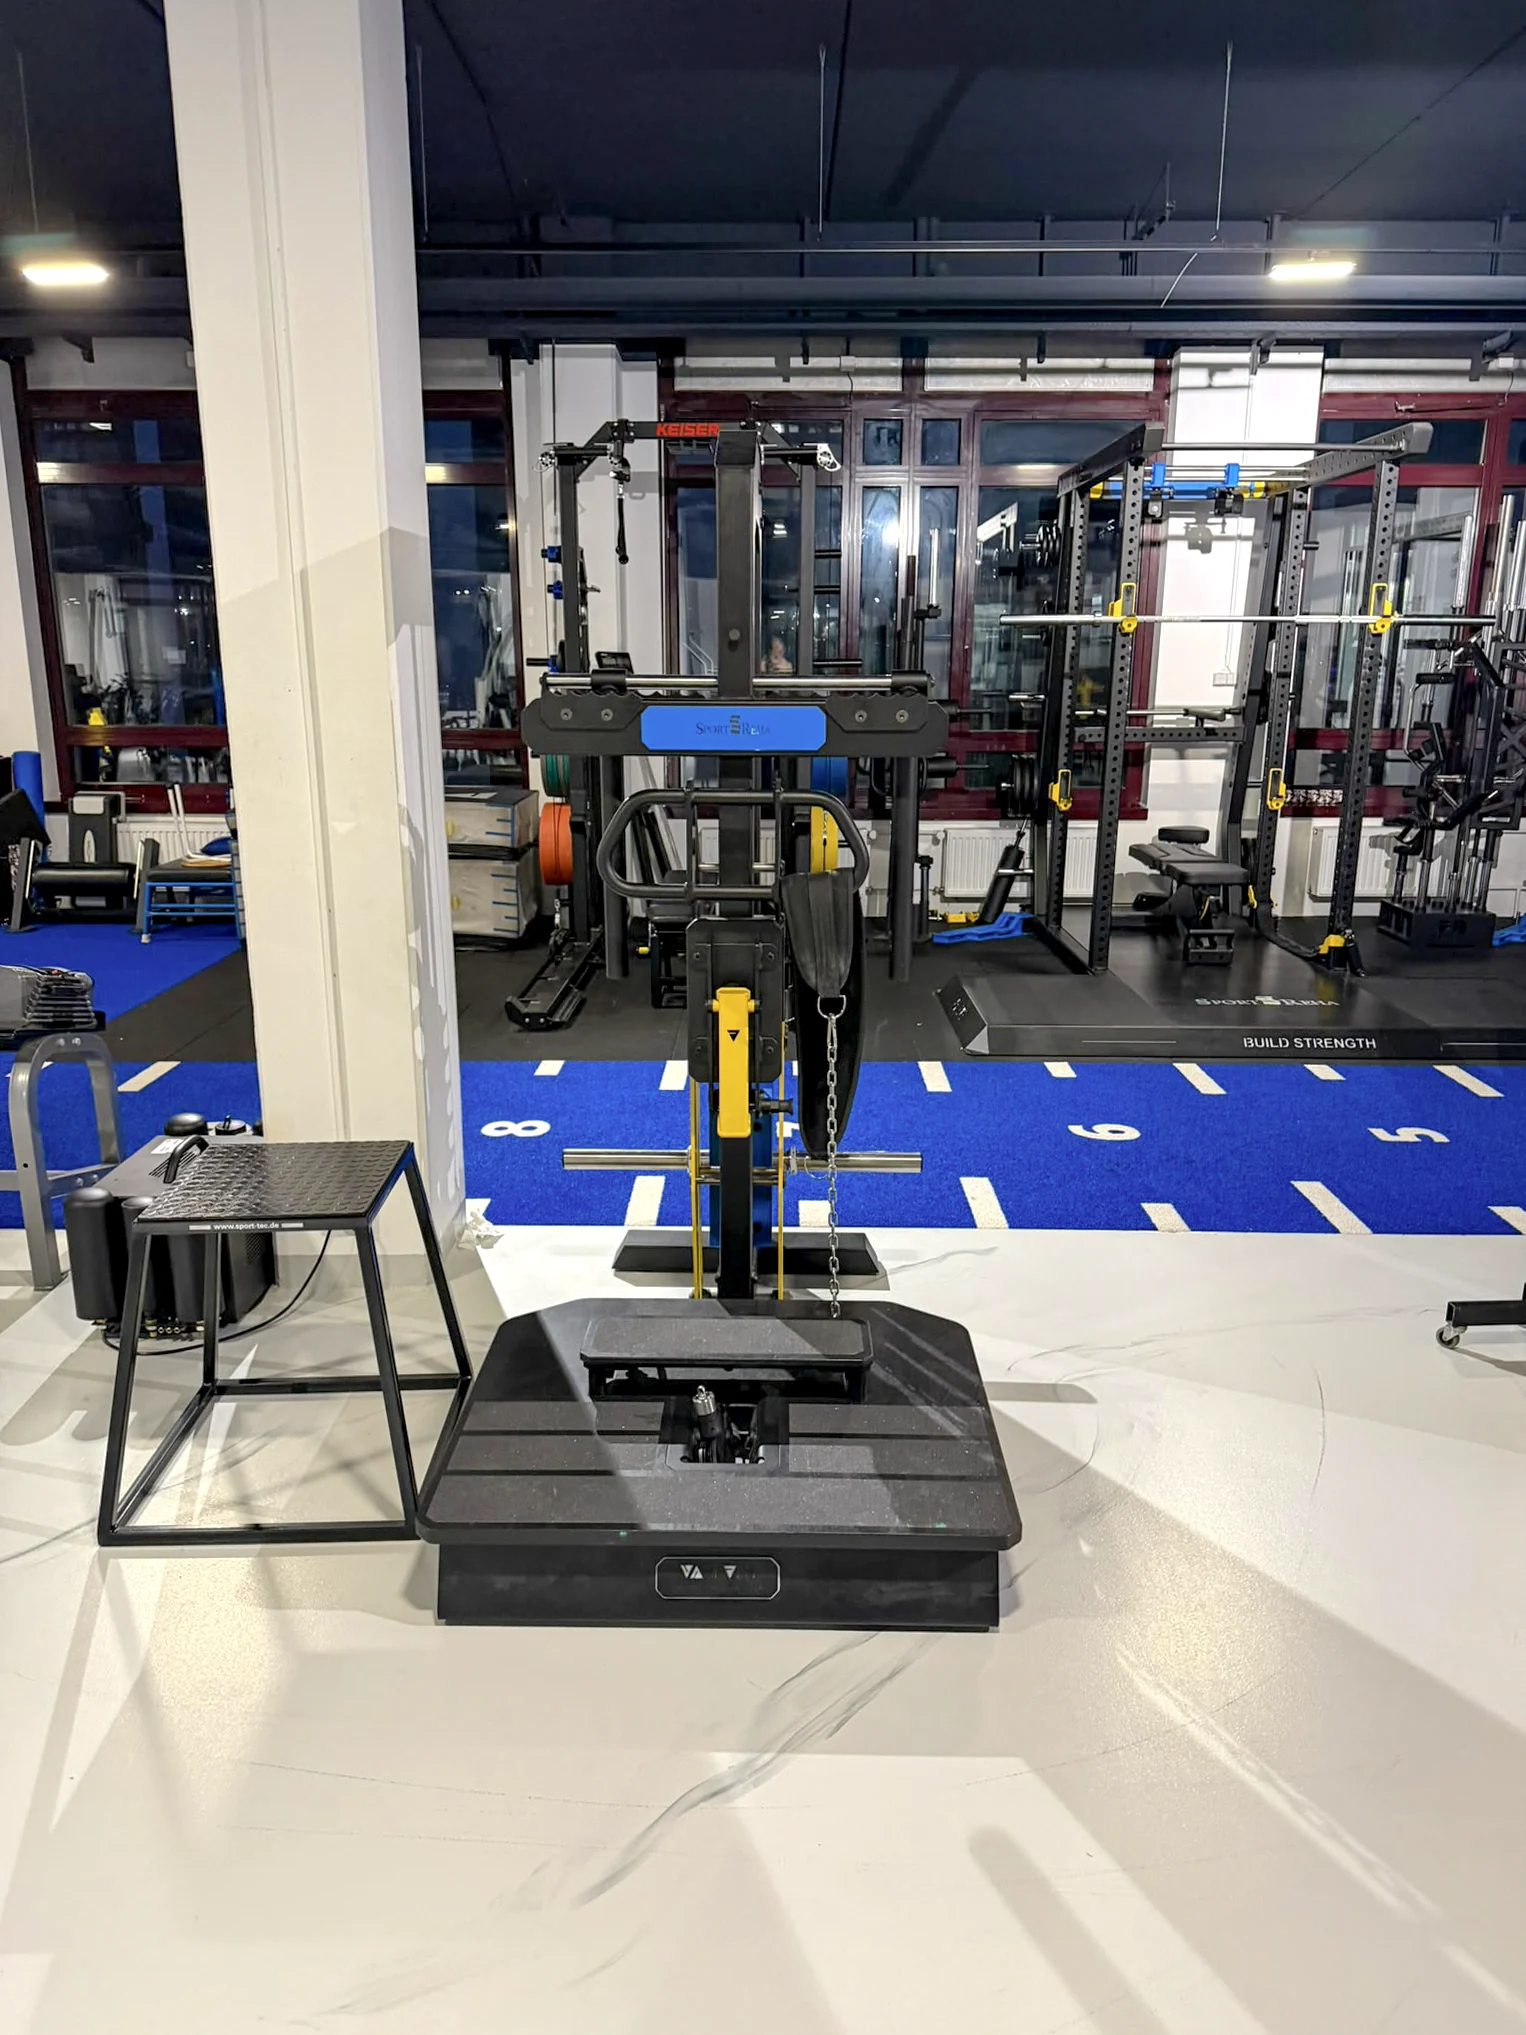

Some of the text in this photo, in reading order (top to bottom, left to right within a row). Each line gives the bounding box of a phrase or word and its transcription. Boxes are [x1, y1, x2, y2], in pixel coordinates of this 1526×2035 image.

[655, 422, 720, 438] KEISER
[1243, 1037, 1377, 1050] BUILD STRENGTH
[480, 1120, 551, 1138] 8
[1367, 1126, 1451, 1143] 5
[213, 1222, 280, 1231] www.sport-tec.de
